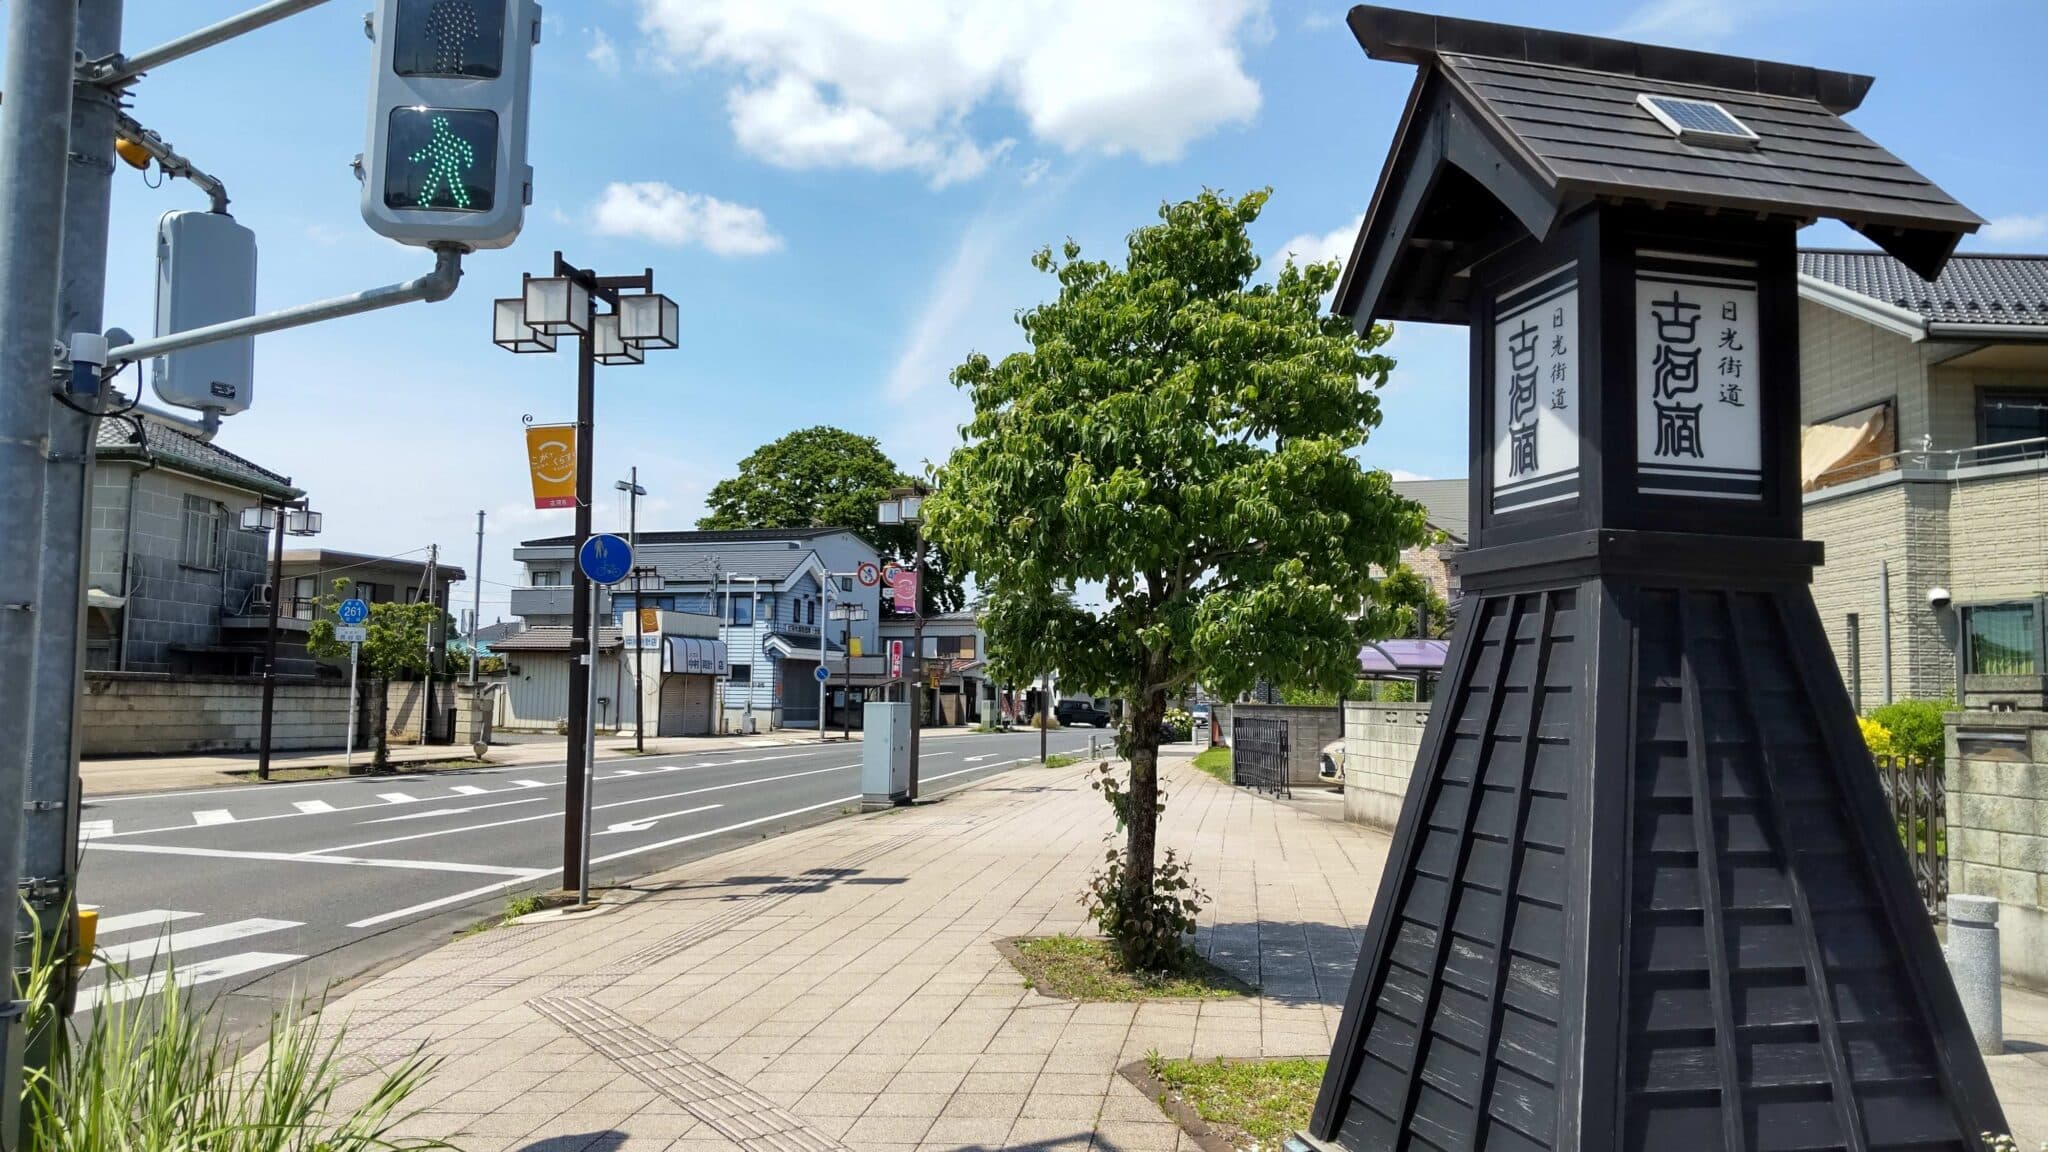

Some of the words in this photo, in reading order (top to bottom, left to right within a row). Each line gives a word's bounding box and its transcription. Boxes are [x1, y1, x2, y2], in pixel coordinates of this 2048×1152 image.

[1550, 307, 1568, 410] 日光街道
[1718, 301, 1745, 407] 日光街道
[344, 606, 361, 617] 261
